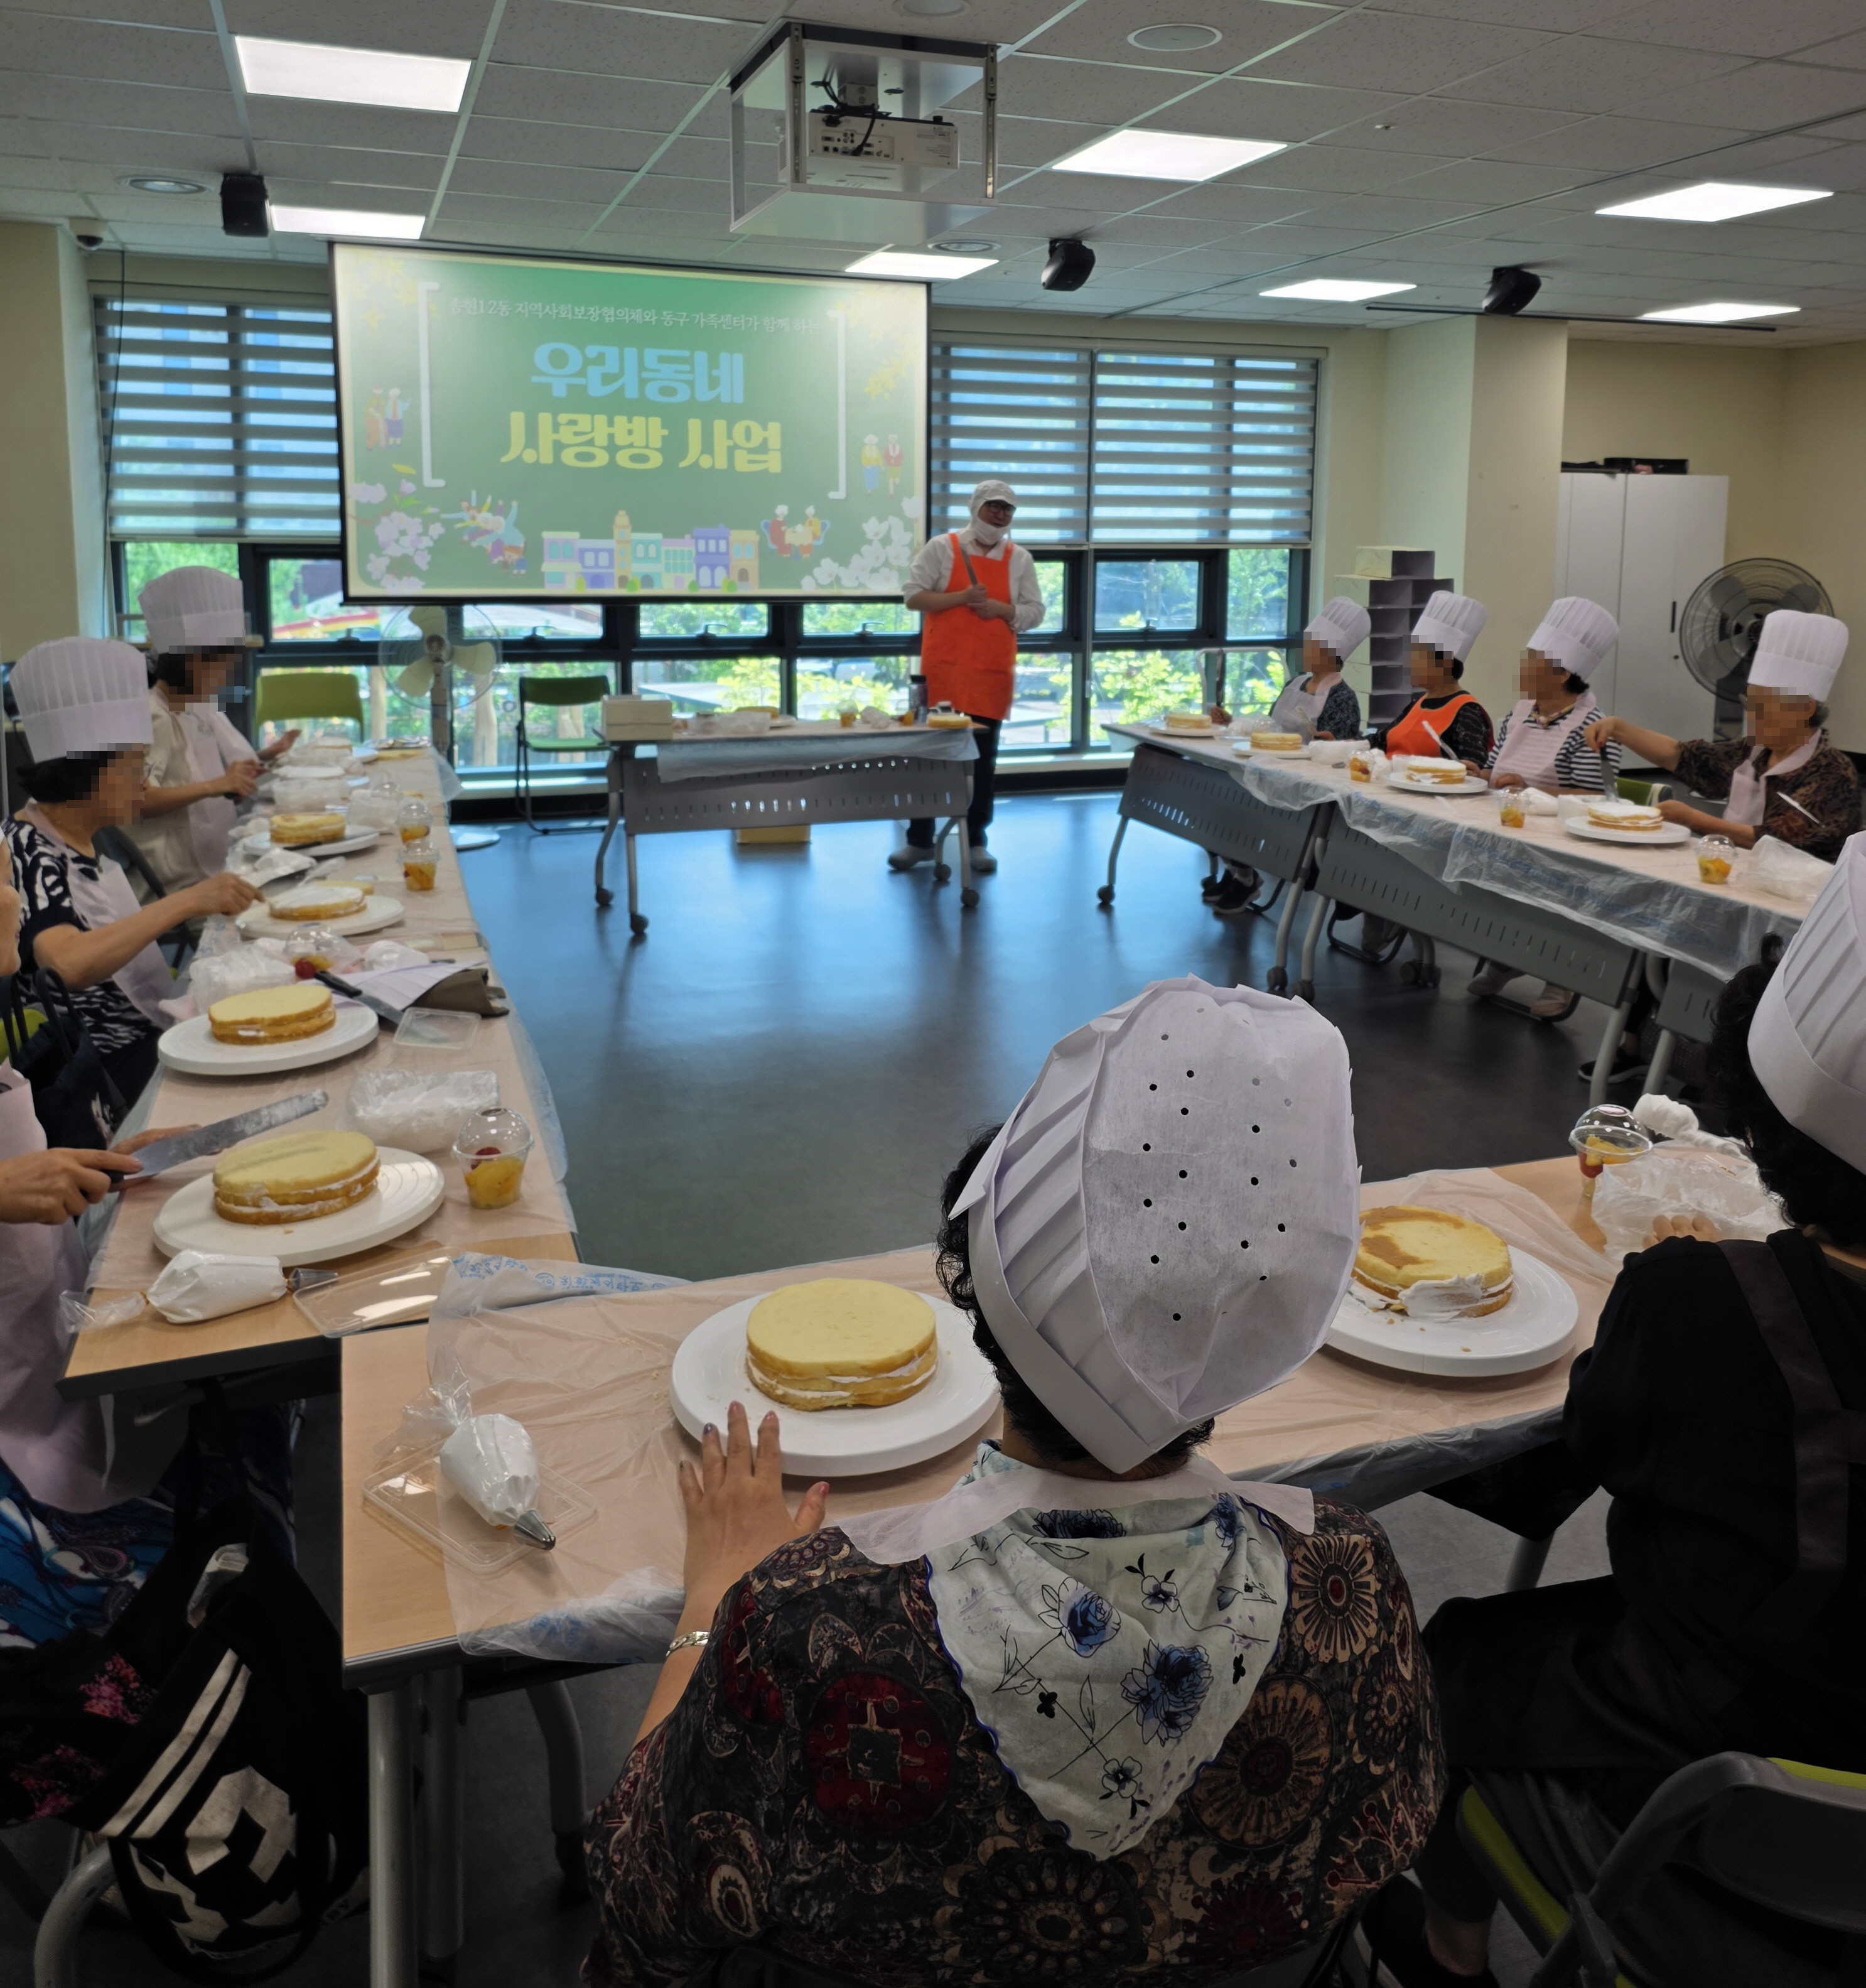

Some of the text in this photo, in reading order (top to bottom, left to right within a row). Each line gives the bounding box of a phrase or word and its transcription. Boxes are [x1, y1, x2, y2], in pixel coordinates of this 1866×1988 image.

[515, 301, 658, 325] 지역사회보장협의체와
[661, 311, 689, 327] 동구
[692, 313, 760, 331] 가족센터가
[762, 316, 790, 333] 함께
[793, 318, 821, 335] 하는
[531, 342, 744, 403] 우리동네
[500, 411, 782, 473] 사랑방 사업
